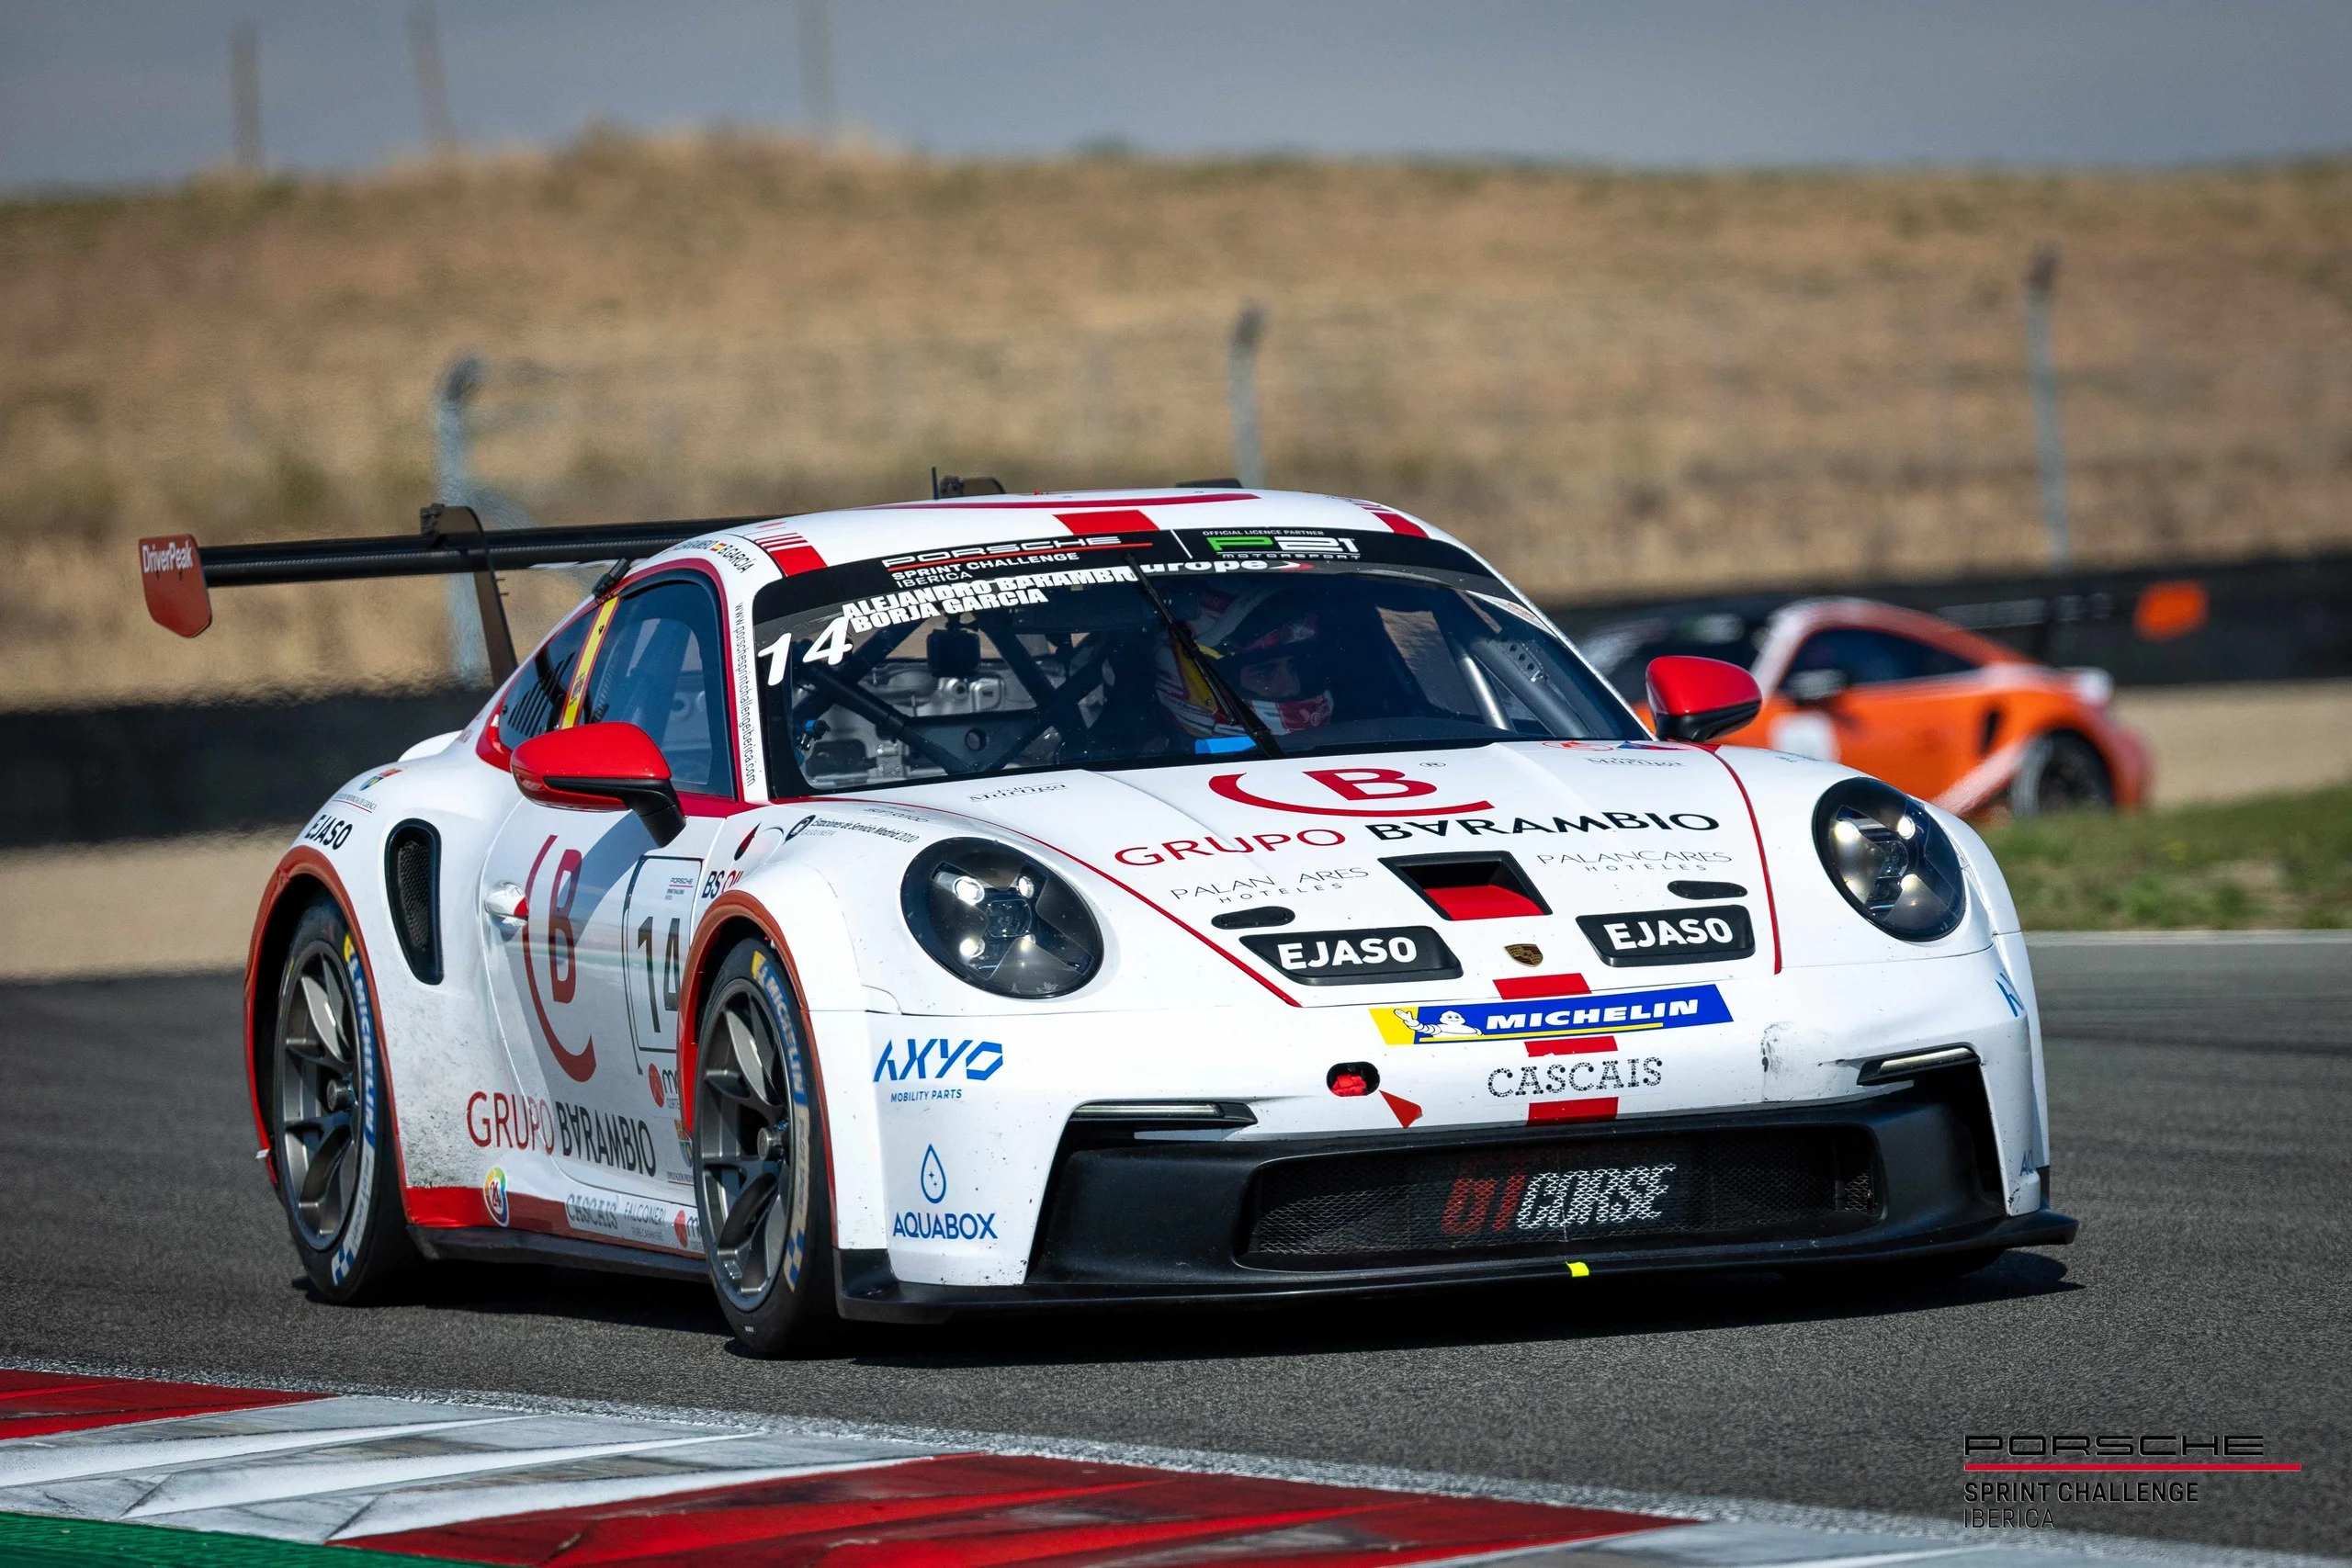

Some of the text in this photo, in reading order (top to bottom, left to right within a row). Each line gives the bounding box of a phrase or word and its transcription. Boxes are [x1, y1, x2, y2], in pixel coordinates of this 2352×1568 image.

[882, 536, 1122, 568] PORSCHE
[891, 552, 1080, 581] SPRINT CHALLENGE
[1139, 559, 1268, 573] urope
[896, 571, 973, 589] IBERICA
[842, 580, 993, 619] ALEJANDRO
[850, 588, 1048, 633] BORJA GARCIA
[758, 615, 853, 686] 14
[304, 815, 353, 850] EJASO
[1114, 829, 1346, 866] GRUPO
[1537, 851, 1732, 864] PALANCARES
[1585, 863, 1706, 872] HOTELES
[1219, 883, 1342, 903] HOTELES
[1603, 918, 1734, 950] EJASO
[1277, 936, 1417, 970] EJASO
[638, 916, 682, 1033] 14
[1487, 998, 1699, 1030] MICHELIN
[765, 976, 805, 1094] MICHELIN
[354, 977, 375, 1134] MICHELIN
[1487, 1056, 1663, 1097] CASCAIS
[890, 1089, 962, 1102] MOBILITY PARTS
[466, 1091, 555, 1156] GRUPO
[892, 1212, 998, 1240] AQUABOX
